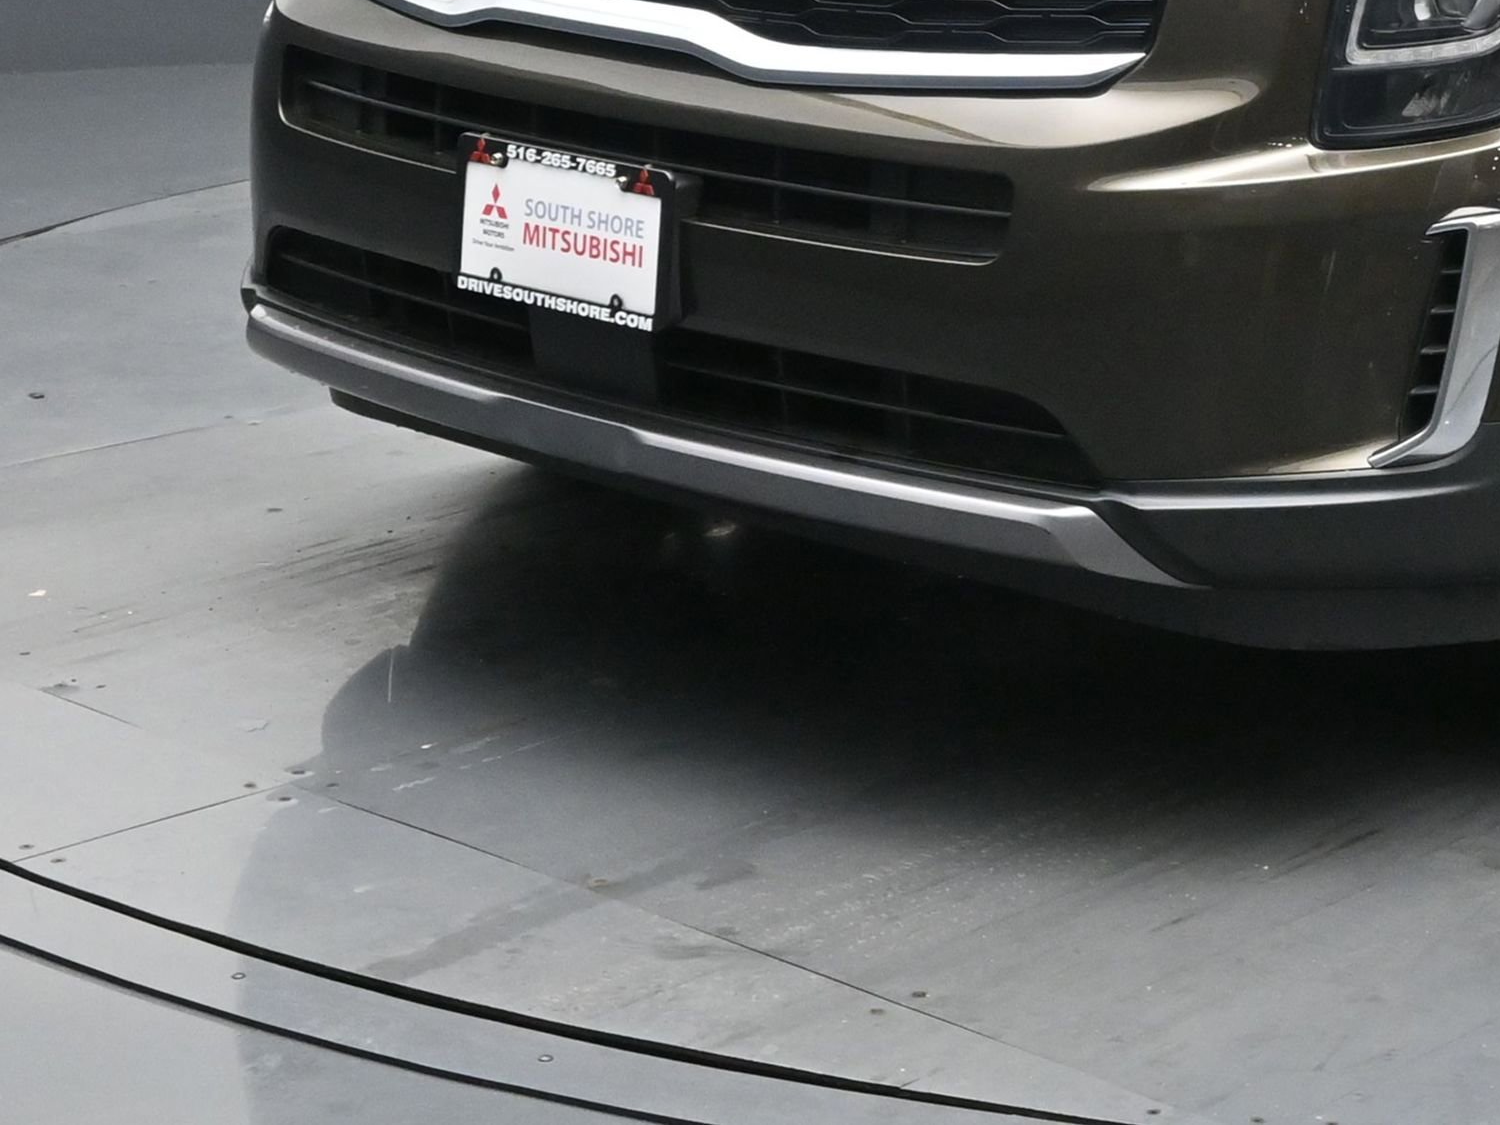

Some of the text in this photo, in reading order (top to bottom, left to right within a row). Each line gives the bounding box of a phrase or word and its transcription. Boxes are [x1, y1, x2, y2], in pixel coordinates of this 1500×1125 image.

[506, 144, 617, 178] 516-265-7665
[524, 198, 645, 239] SOUTH SHORE
[522, 222, 644, 268] MITSUBISHI
[457, 275, 653, 332] DRIVESOUTHSHORE.COM
